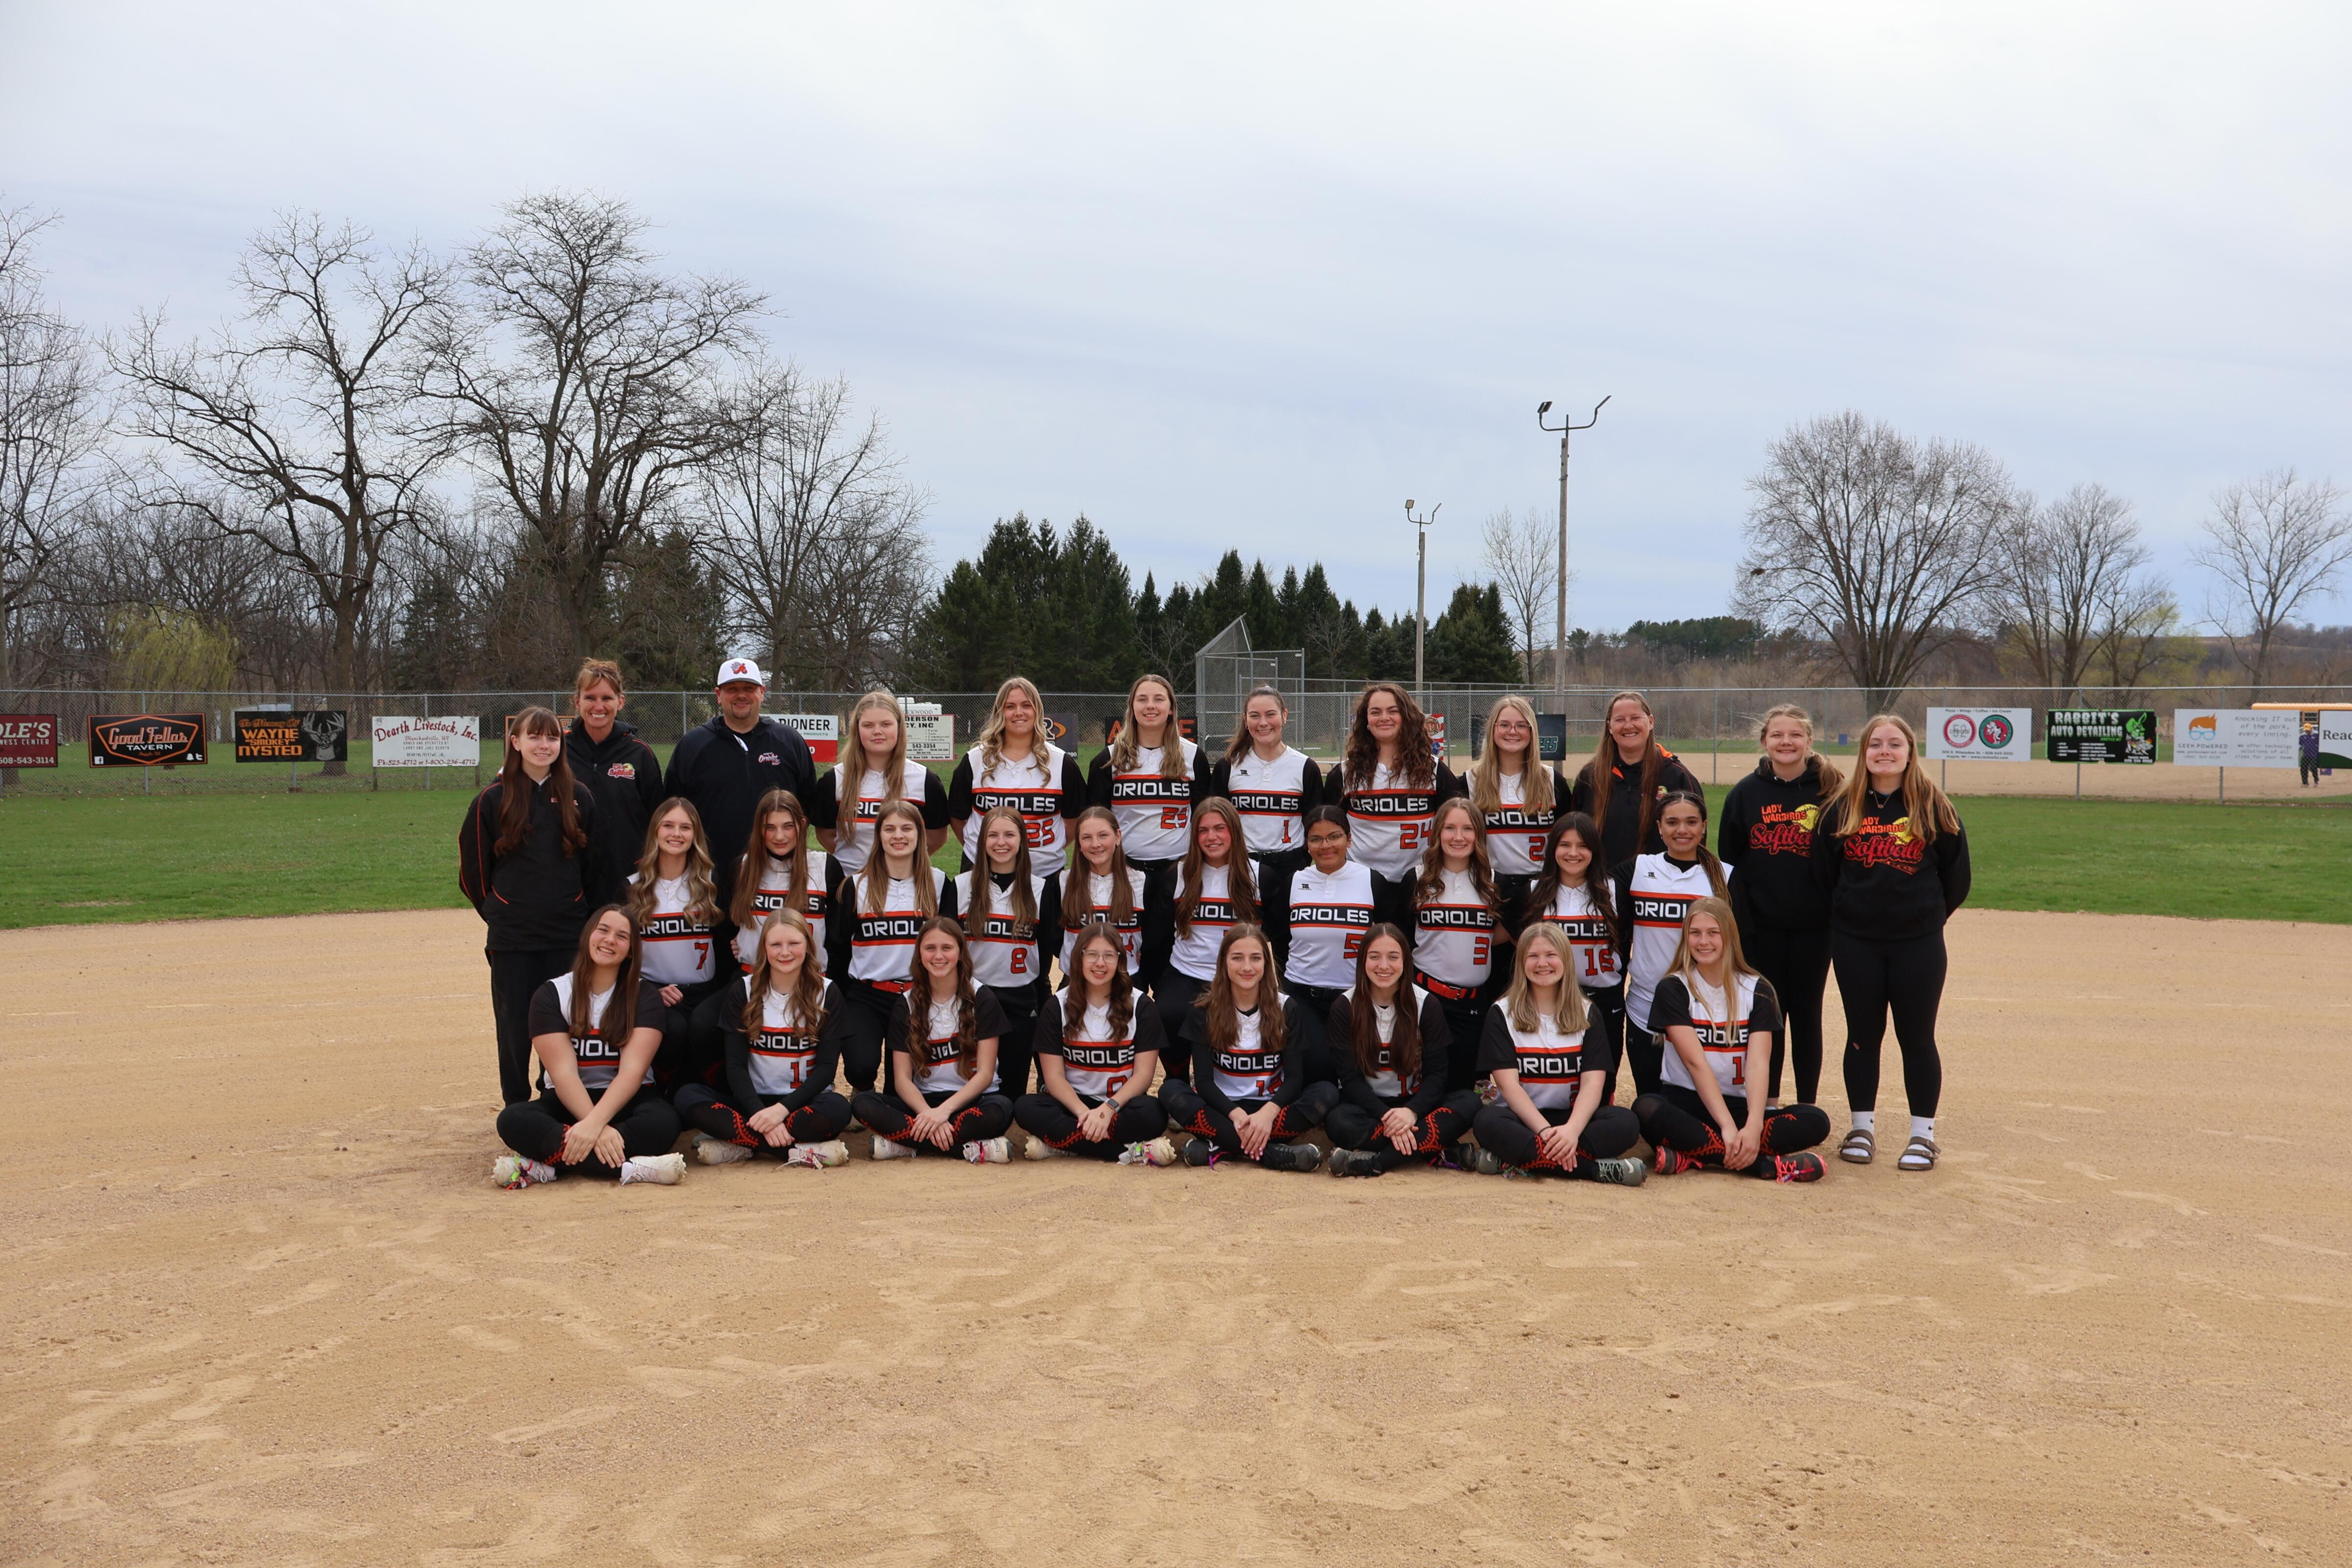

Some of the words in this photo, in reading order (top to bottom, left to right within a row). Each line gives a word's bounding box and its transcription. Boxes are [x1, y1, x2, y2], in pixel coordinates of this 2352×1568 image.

[2055, 712, 2119, 725] RABBIT'S
[108, 727, 145, 750] Good
[147, 727, 188, 744] Fellas
[241, 729, 298, 738] WAYNE
[374, 721, 410, 741] Dearth
[414, 718, 458, 735] Livestock,
[461, 725, 478, 742] Inc.
[2051, 726, 2073, 737] AUTO
[2077, 726, 2123, 737] DETAILING
[1113, 782, 1190, 797] ORIOLES
[976, 794, 1055, 812] ORIOLES
[1231, 796, 1298, 810] ORIOLES
[1349, 798, 1428, 812] ORIOLES
[1762, 804, 1783, 814] LADY
[1485, 810, 1554, 826] RIOLES
[1763, 811, 1807, 824] WARBIRDS
[1862, 816, 1880, 826] ADY
[1025, 818, 1055, 848] 25
[1281, 820, 1291, 843] 1
[1400, 821, 1432, 849] 24
[1751, 824, 1813, 855] Softba
[1529, 836, 1551, 862] 2
[1844, 834, 1926, 867] Softball
[752, 895, 819, 910] RIOS
[1635, 901, 1687, 918] ORIO
[1080, 913, 1137, 926] RIOLS
[1192, 905, 1238, 919] RIOL
[1290, 908, 1370, 923] ORIOLES
[1421, 910, 1494, 926] ORIOLES
[861, 920, 926, 937] ORIOL
[963, 921, 1033, 938] IOLS
[1559, 923, 1609, 937] IOLE
[694, 942, 709, 970] 7
[1473, 936, 1490, 965] 3
[1010, 947, 1028, 974] 8
[750, 1034, 817, 1050] RIOLE
[1695, 1028, 1749, 1044] RIOE
[571, 1037, 622, 1057] RIOL
[931, 1041, 960, 1060] RIOL
[1062, 1045, 1135, 1064] ORIOLES
[1212, 1049, 1280, 1070] ORIOLES
[1517, 1055, 1583, 1074] RIOL
[1732, 1056, 1746, 1085] 1
